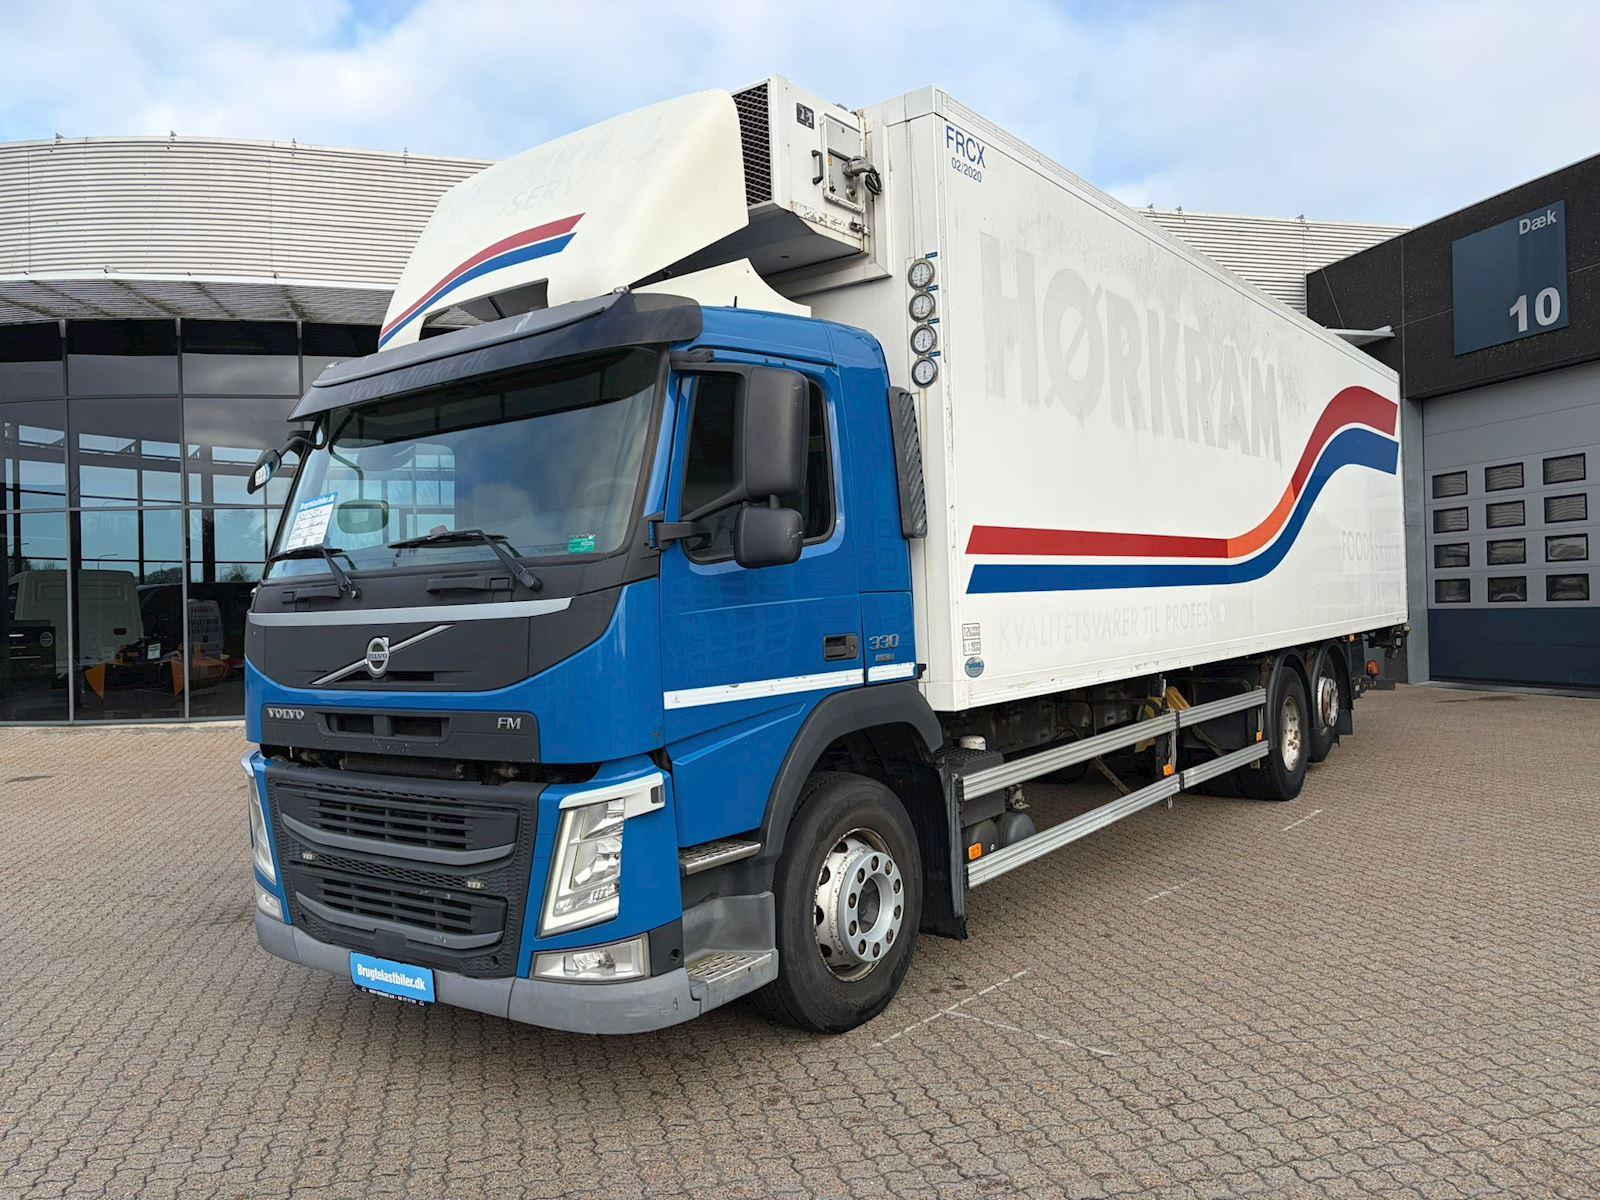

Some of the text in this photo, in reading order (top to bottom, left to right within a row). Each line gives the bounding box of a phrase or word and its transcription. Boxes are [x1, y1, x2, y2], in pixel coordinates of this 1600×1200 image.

[946, 124, 986, 169] FRCX
[951, 157, 983, 183] 02/2020
[1518, 209, 1558, 236] Dæk
[1509, 286, 1562, 333] 10
[979, 230, 1283, 464] HØRKRAM
[349, 350, 491, 401] www.hoka.dk
[1142, 603, 1160, 635] TIL
[869, 633, 900, 651] 330
[266, 707, 305, 721] VOLVO
[496, 716, 522, 730] FM
[356, 963, 427, 991] Brugtelastbiler.dk
